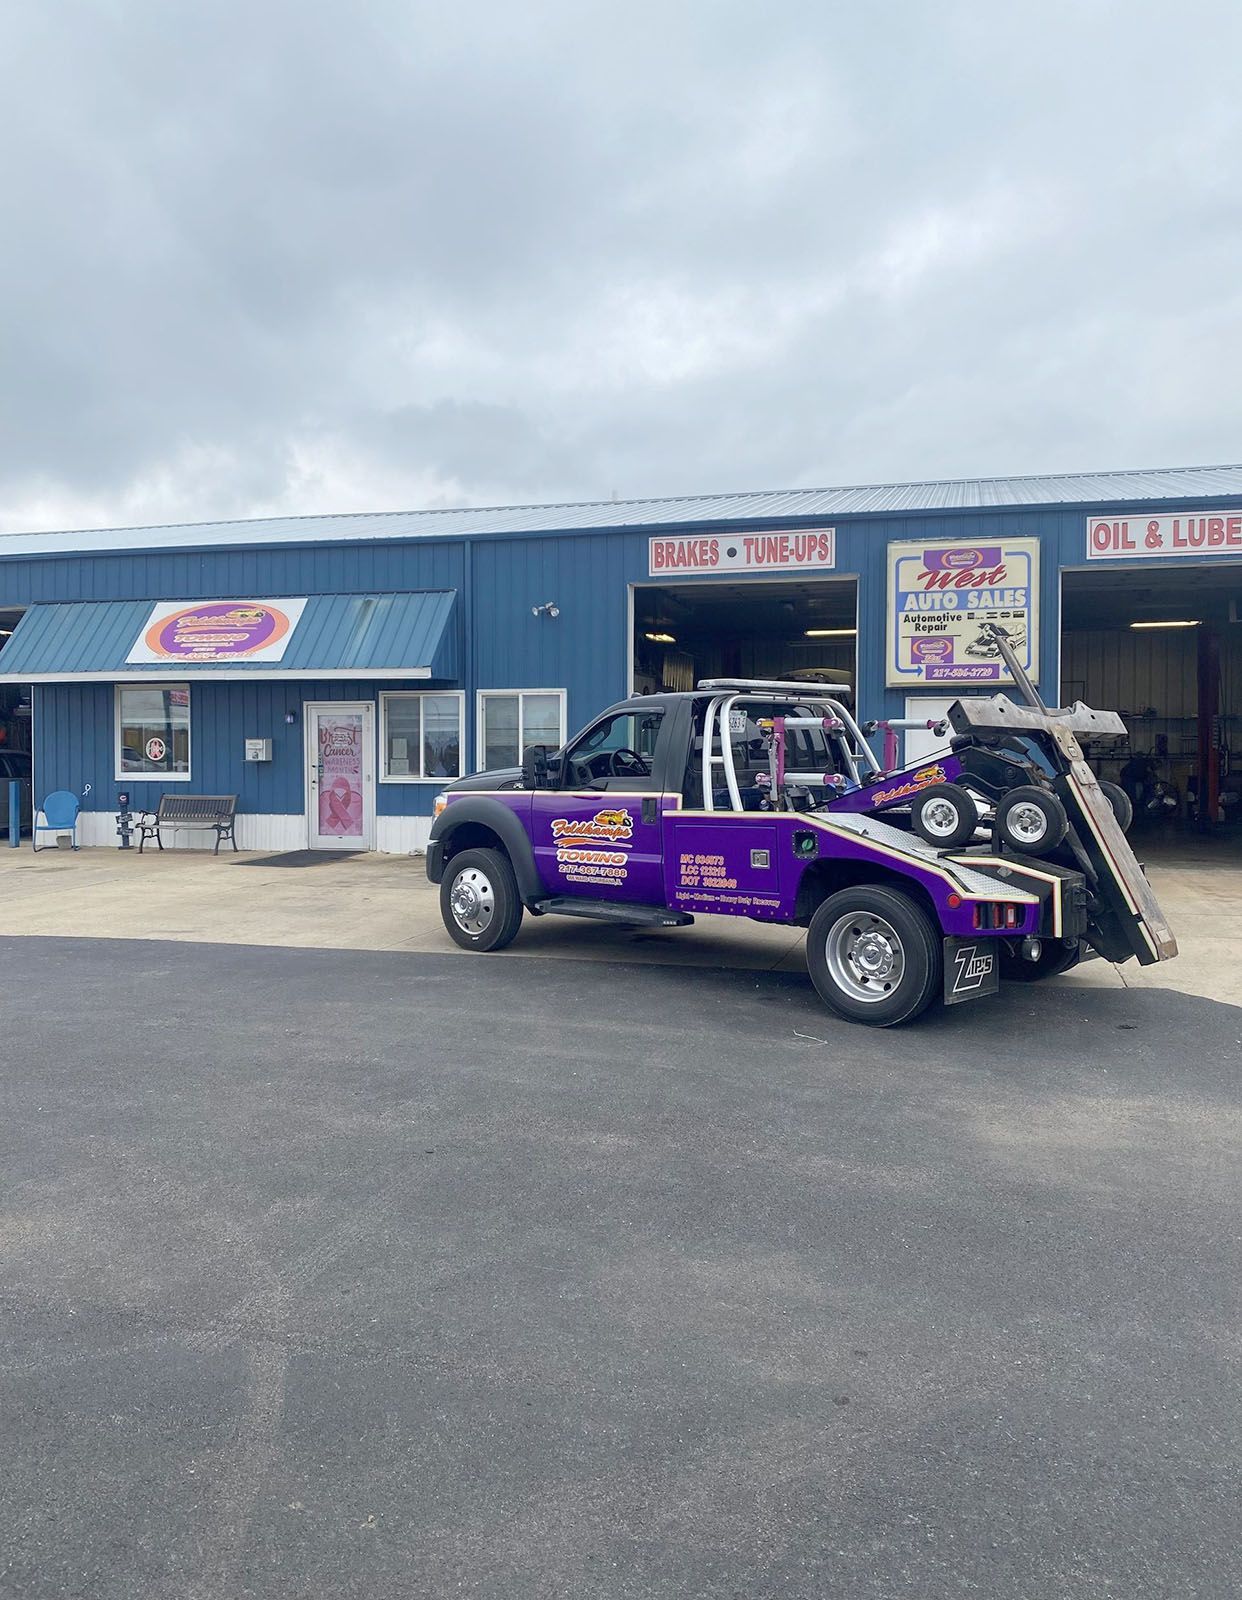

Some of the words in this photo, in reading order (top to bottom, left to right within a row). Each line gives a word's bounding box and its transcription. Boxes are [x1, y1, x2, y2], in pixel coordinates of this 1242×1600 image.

[1093, 523, 1136, 550] OIL
[1145, 520, 1164, 549] &
[1173, 517, 1241, 547] LUBE
[654, 539, 720, 568] BRAKES
[743, 533, 829, 565] TUNE-UPS
[917, 564, 1008, 591] West
[904, 591, 958, 611] AUTO
[967, 589, 1026, 609] SALES
[903, 612, 962, 623] Automotive
[914, 622, 948, 634] Repair
[173, 633, 250, 643] TOWING
[320, 727, 362, 746] Brst
[323, 743, 357, 757] Cancer
[323, 757, 361, 767] WARENESS
[556, 849, 628, 866] TOWING
[680, 854, 694, 864] MC
[559, 864, 628, 878] 217-367-7888
[681, 875, 700, 886] DOT
[752, 897, 780, 909] Recovery
